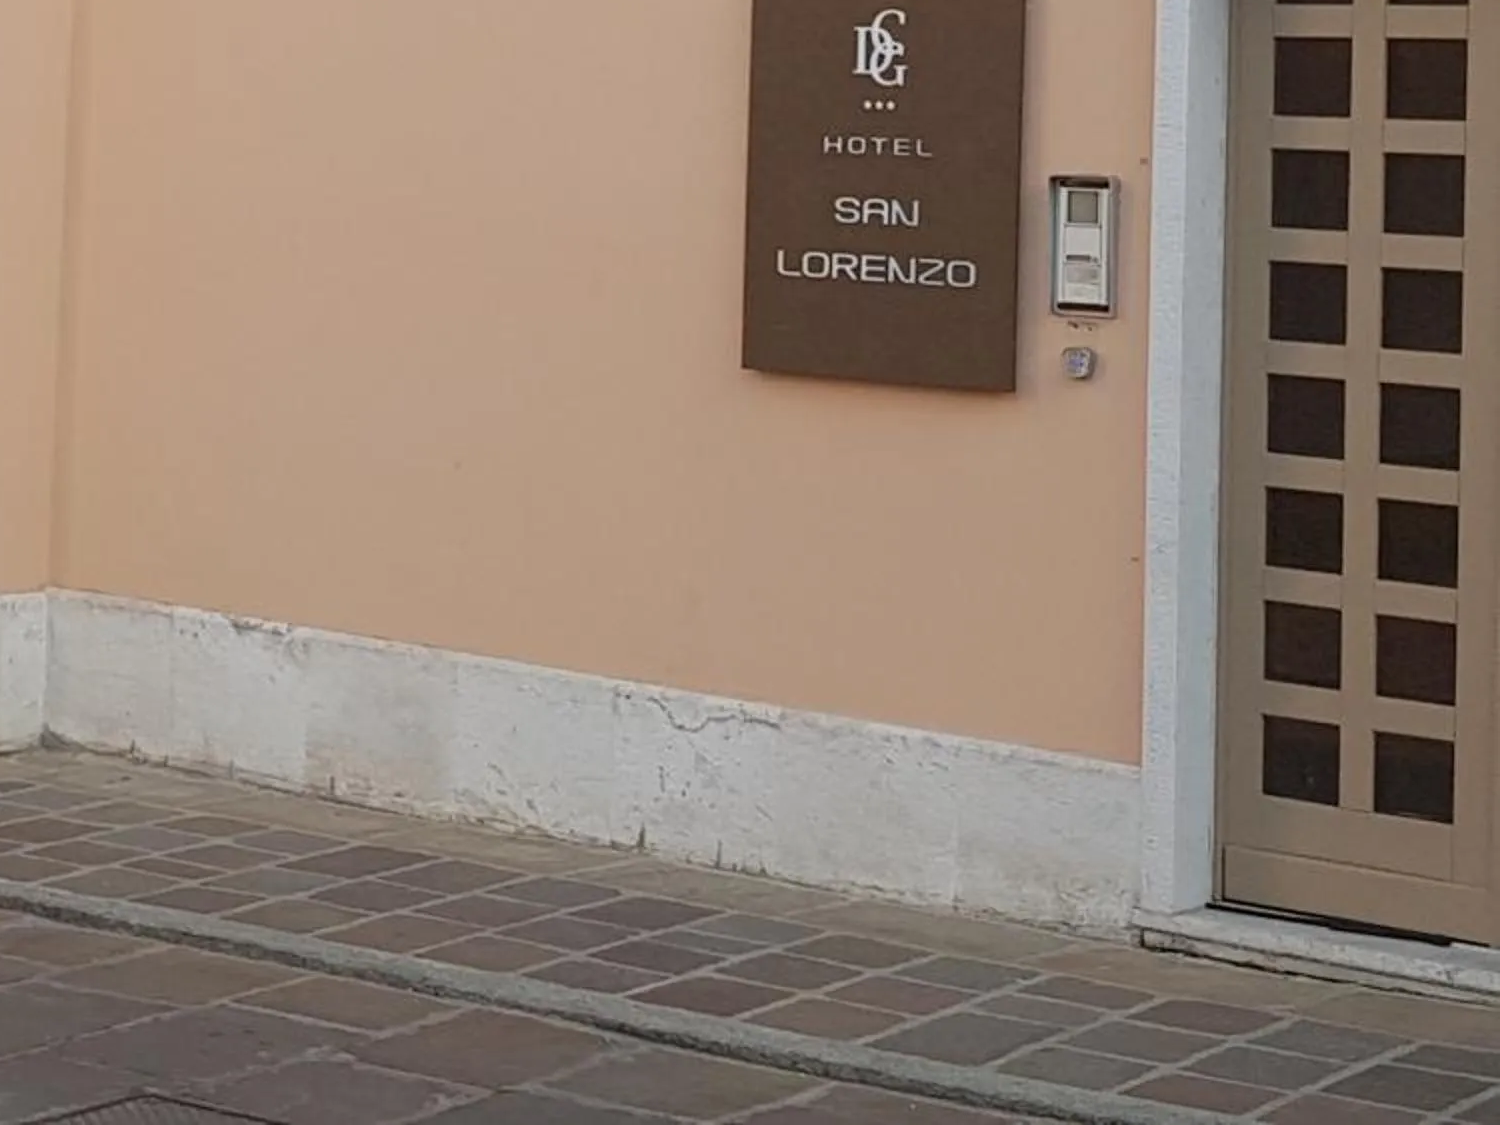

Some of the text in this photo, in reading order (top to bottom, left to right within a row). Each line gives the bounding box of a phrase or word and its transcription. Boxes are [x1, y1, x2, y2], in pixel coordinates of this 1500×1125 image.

[822, 135, 933, 157] HOTEL
[834, 196, 920, 227] SAN
[777, 249, 977, 288] LORENZO
